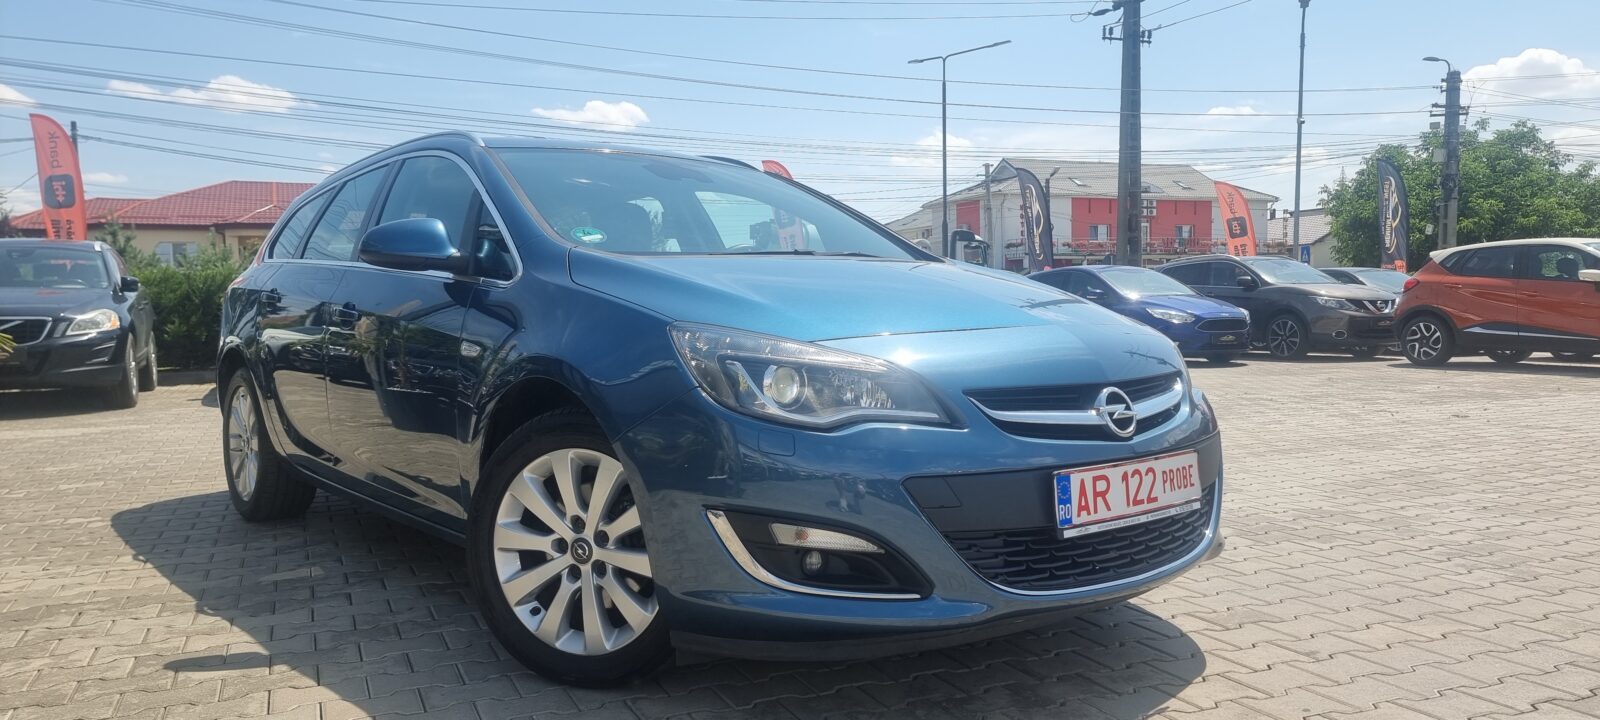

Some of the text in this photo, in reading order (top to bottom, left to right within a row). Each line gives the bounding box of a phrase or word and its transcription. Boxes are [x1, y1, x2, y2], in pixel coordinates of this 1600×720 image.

[1077, 464, 1195, 517] AR 122 PROBE
[1059, 504, 1072, 520] RO
